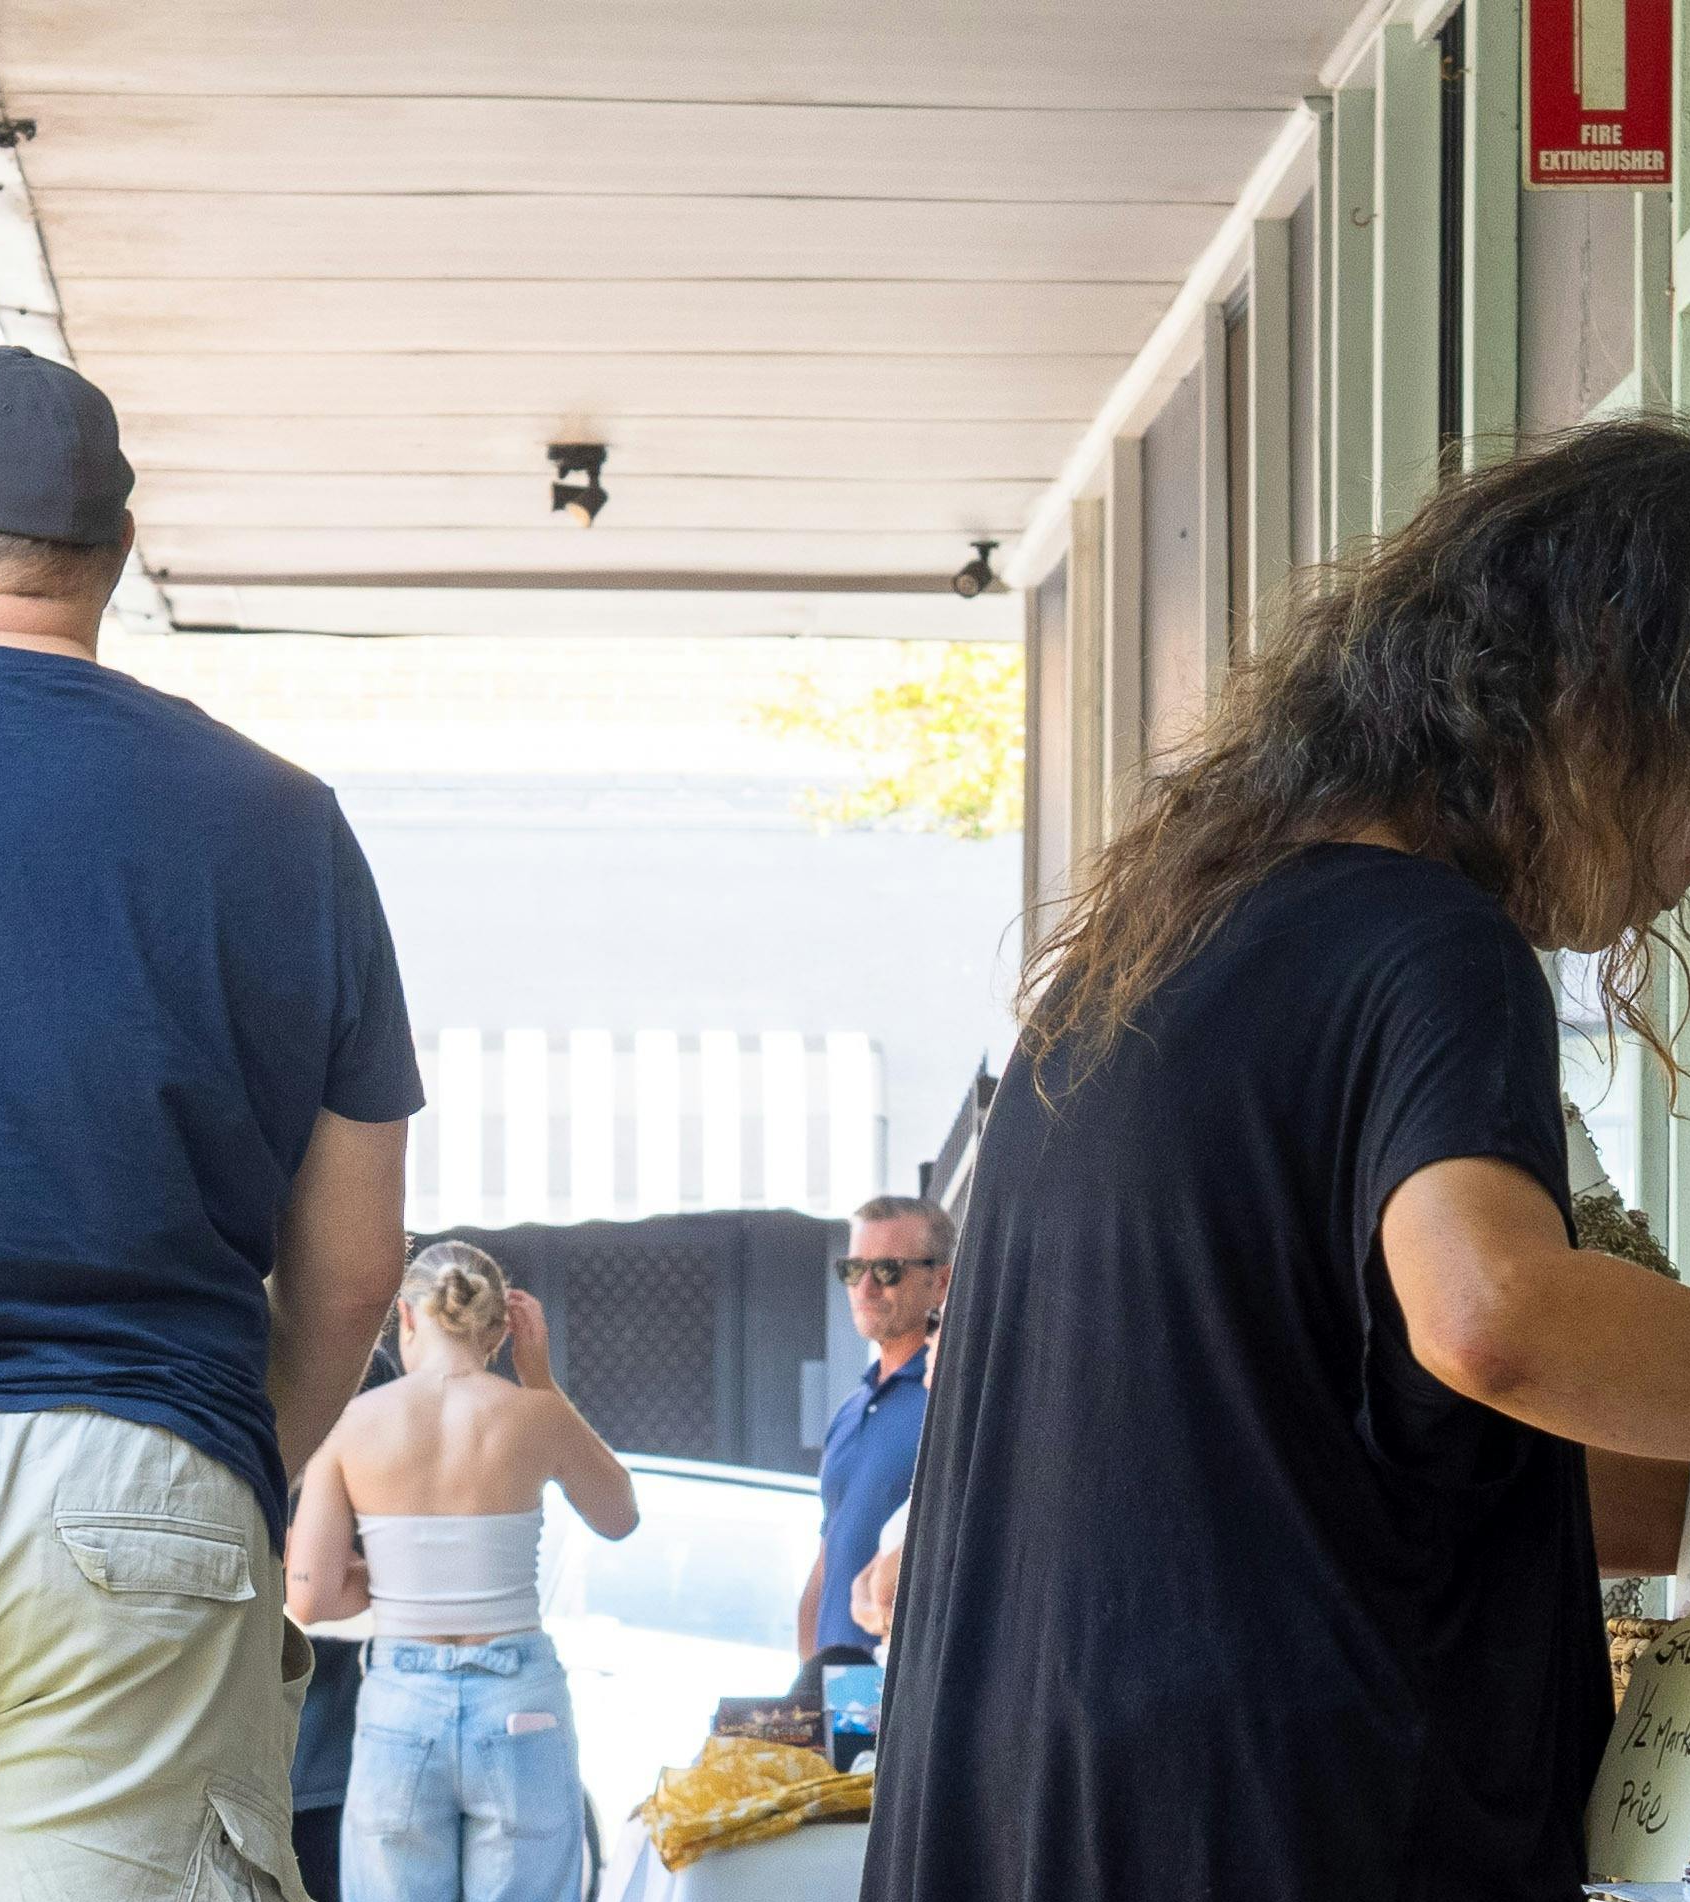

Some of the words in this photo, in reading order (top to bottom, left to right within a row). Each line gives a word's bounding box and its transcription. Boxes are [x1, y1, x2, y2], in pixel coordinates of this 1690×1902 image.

[1580, 124, 1623, 145] FIRE
[1539, 151, 1665, 171] EXTINGUISHER
[1612, 1780, 1669, 1834] Price
